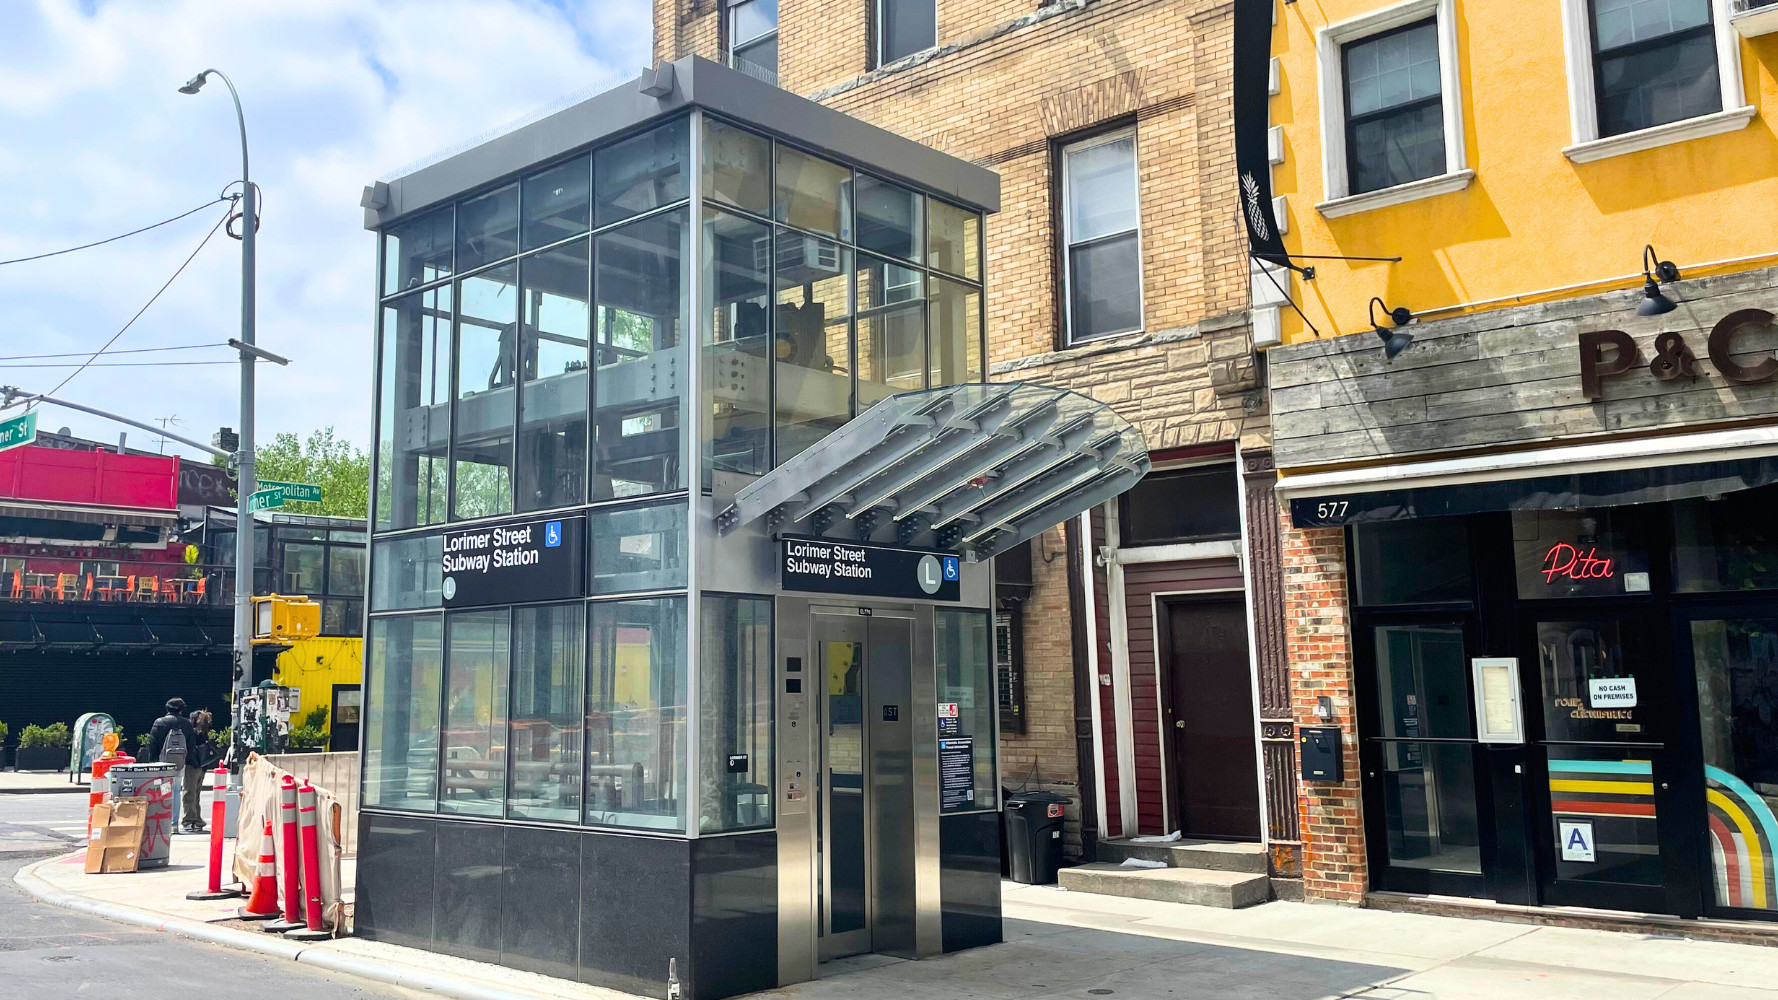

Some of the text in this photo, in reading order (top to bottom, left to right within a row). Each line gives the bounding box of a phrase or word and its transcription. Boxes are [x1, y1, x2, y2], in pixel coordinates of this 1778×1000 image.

[1317, 501, 1349, 518] 577
[443, 526, 532, 552] Lorimer Street
[443, 547, 539, 573] Subway Station
[787, 541, 866, 563] Lorimer Street
[1541, 542, 1614, 584] Pita
[787, 558, 872, 579] Subway Station
[925, 562, 936, 585] L
[1567, 828, 1588, 850] A
